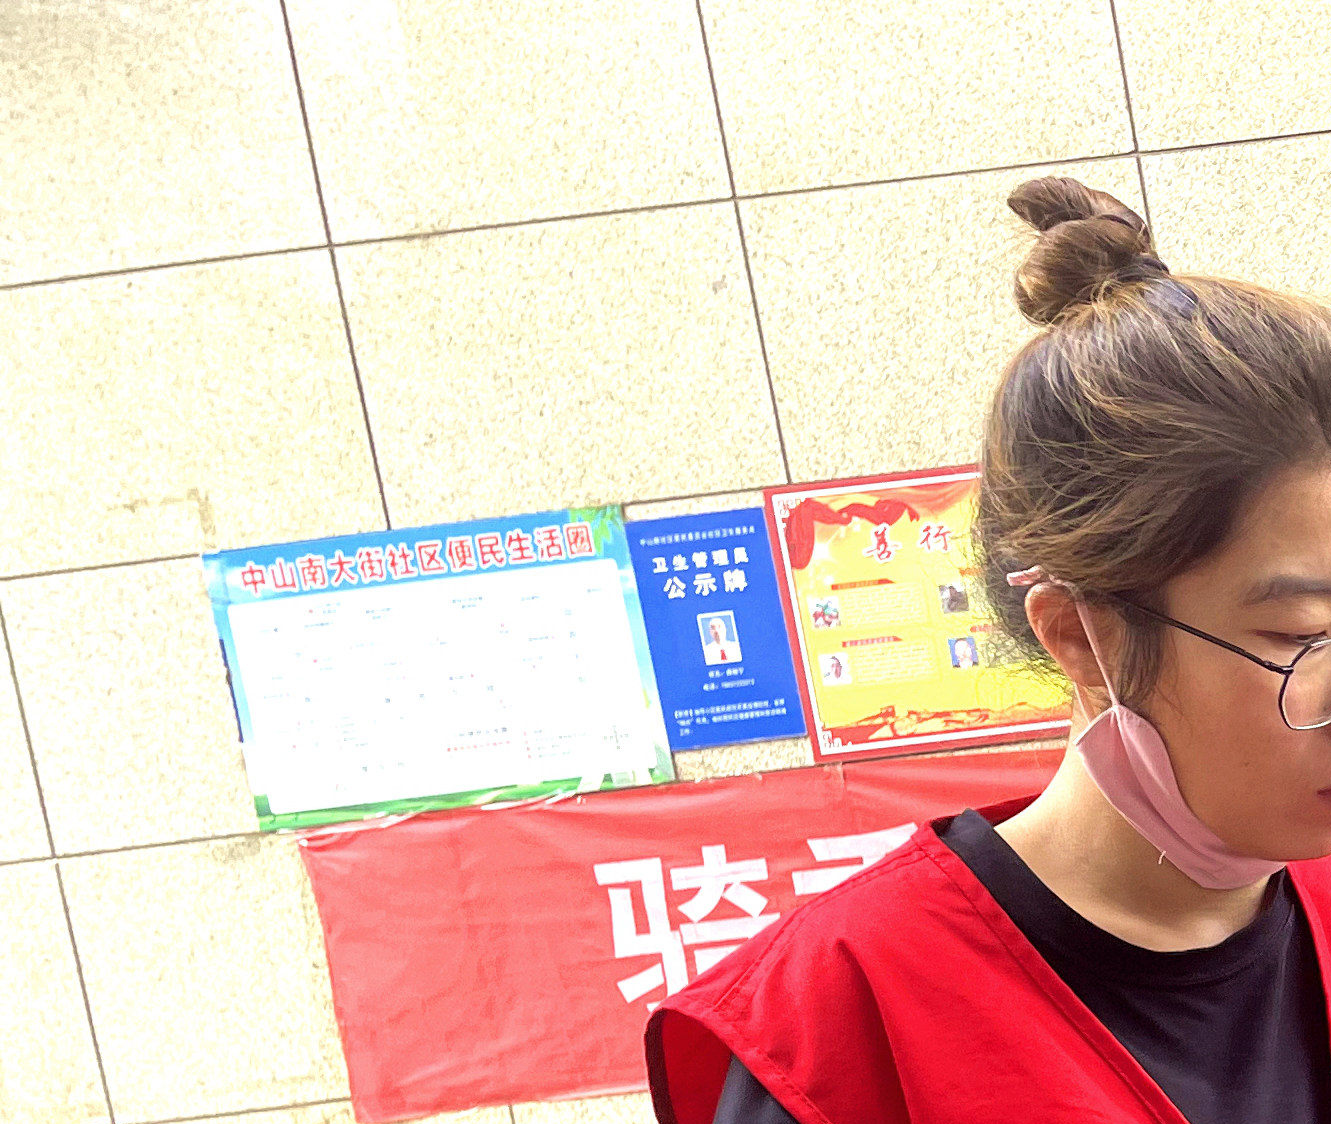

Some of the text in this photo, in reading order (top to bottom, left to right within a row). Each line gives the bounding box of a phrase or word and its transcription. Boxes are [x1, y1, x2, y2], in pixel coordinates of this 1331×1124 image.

[240, 523, 595, 596] 中山南大街社区便民生活圈
[652, 547, 749, 574] 卫生管理员
[866, 524, 952, 563] 善行
[663, 568, 748, 600] 公示牌
